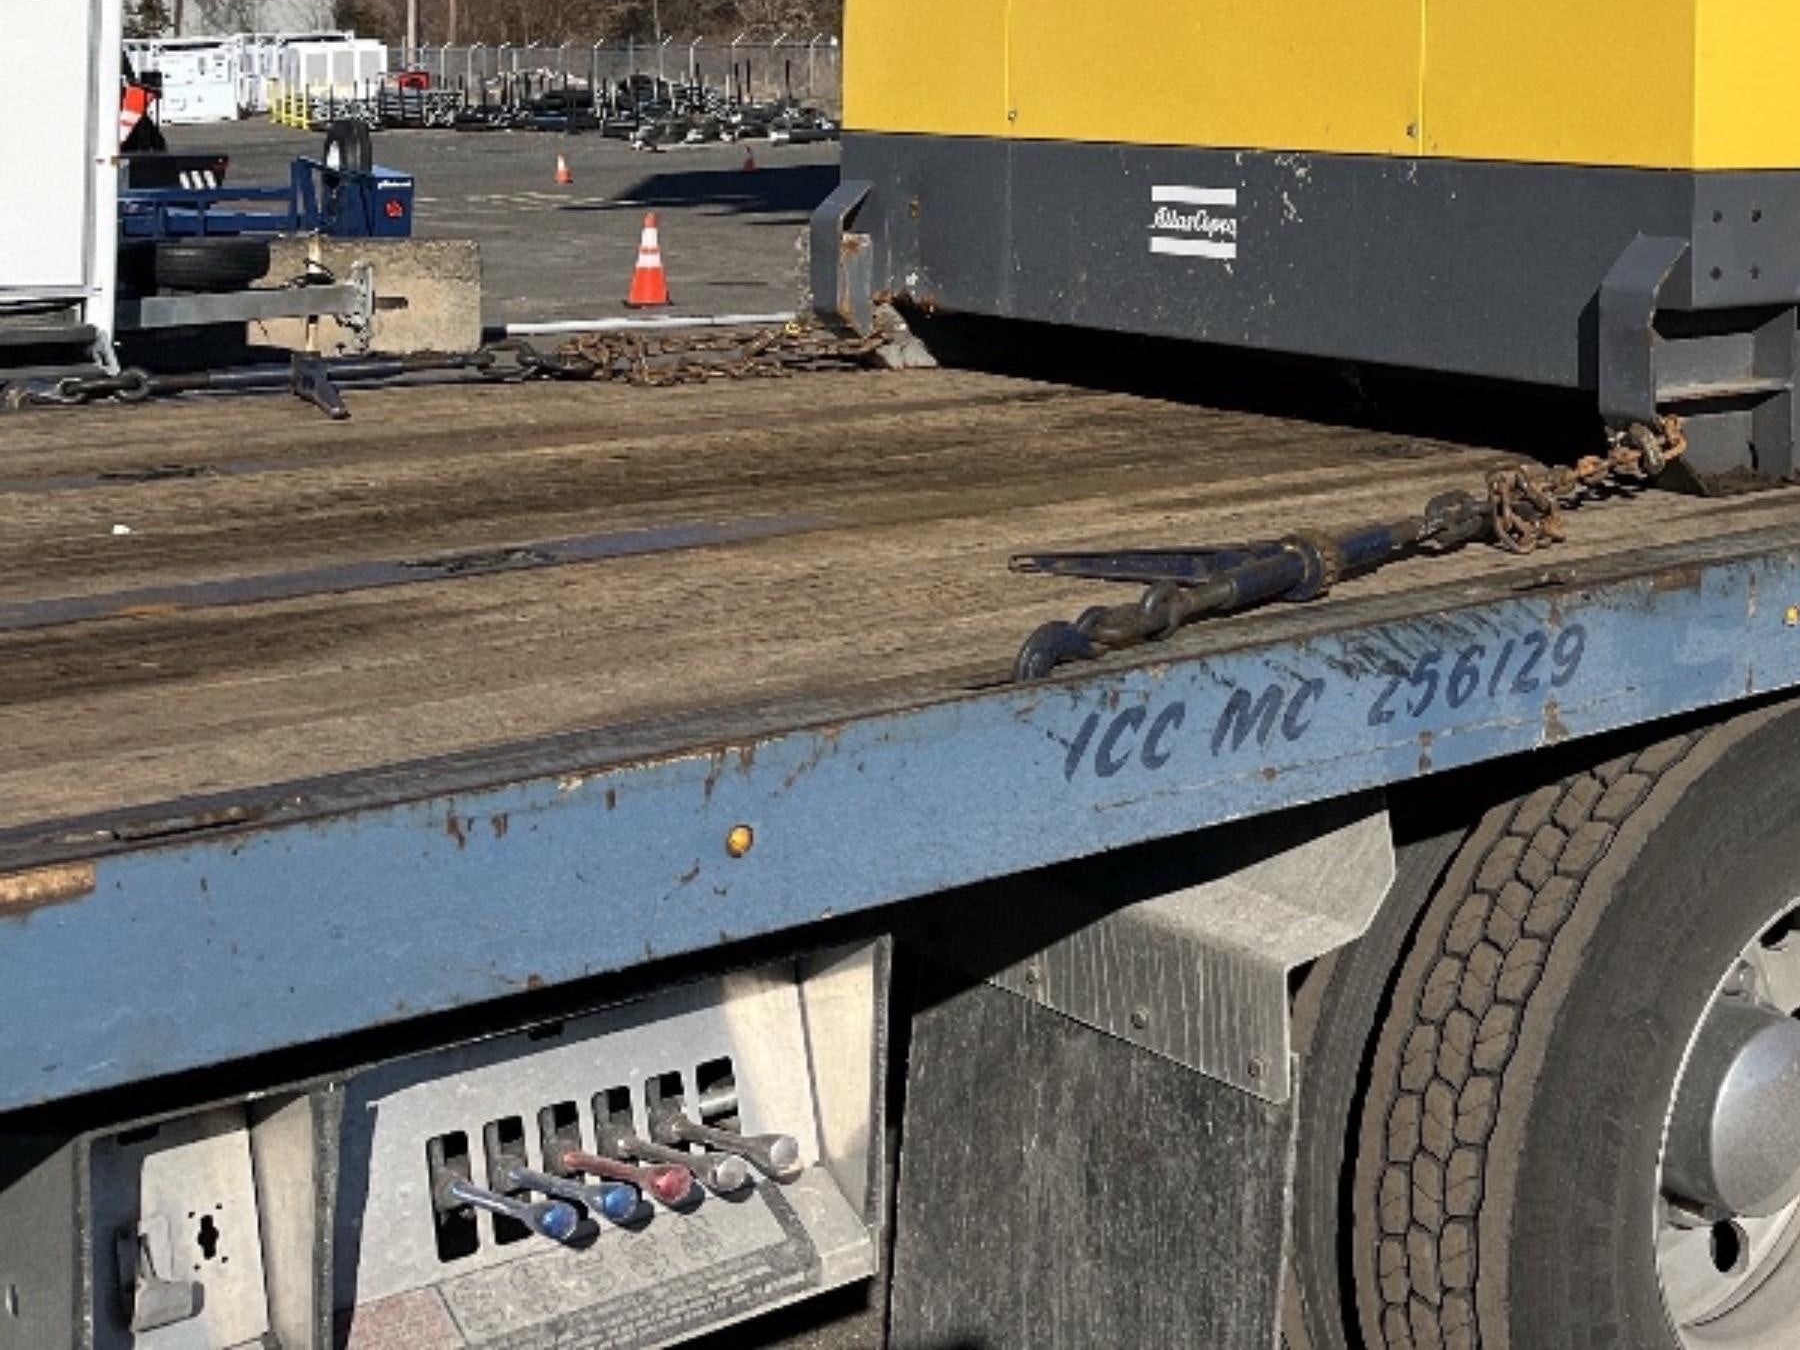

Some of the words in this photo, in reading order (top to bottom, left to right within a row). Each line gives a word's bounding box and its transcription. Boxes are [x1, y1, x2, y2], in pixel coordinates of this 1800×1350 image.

[1065, 701, 1186, 782] ICC
[1211, 677, 1326, 756] MC
[1367, 623, 1588, 726] 256129
